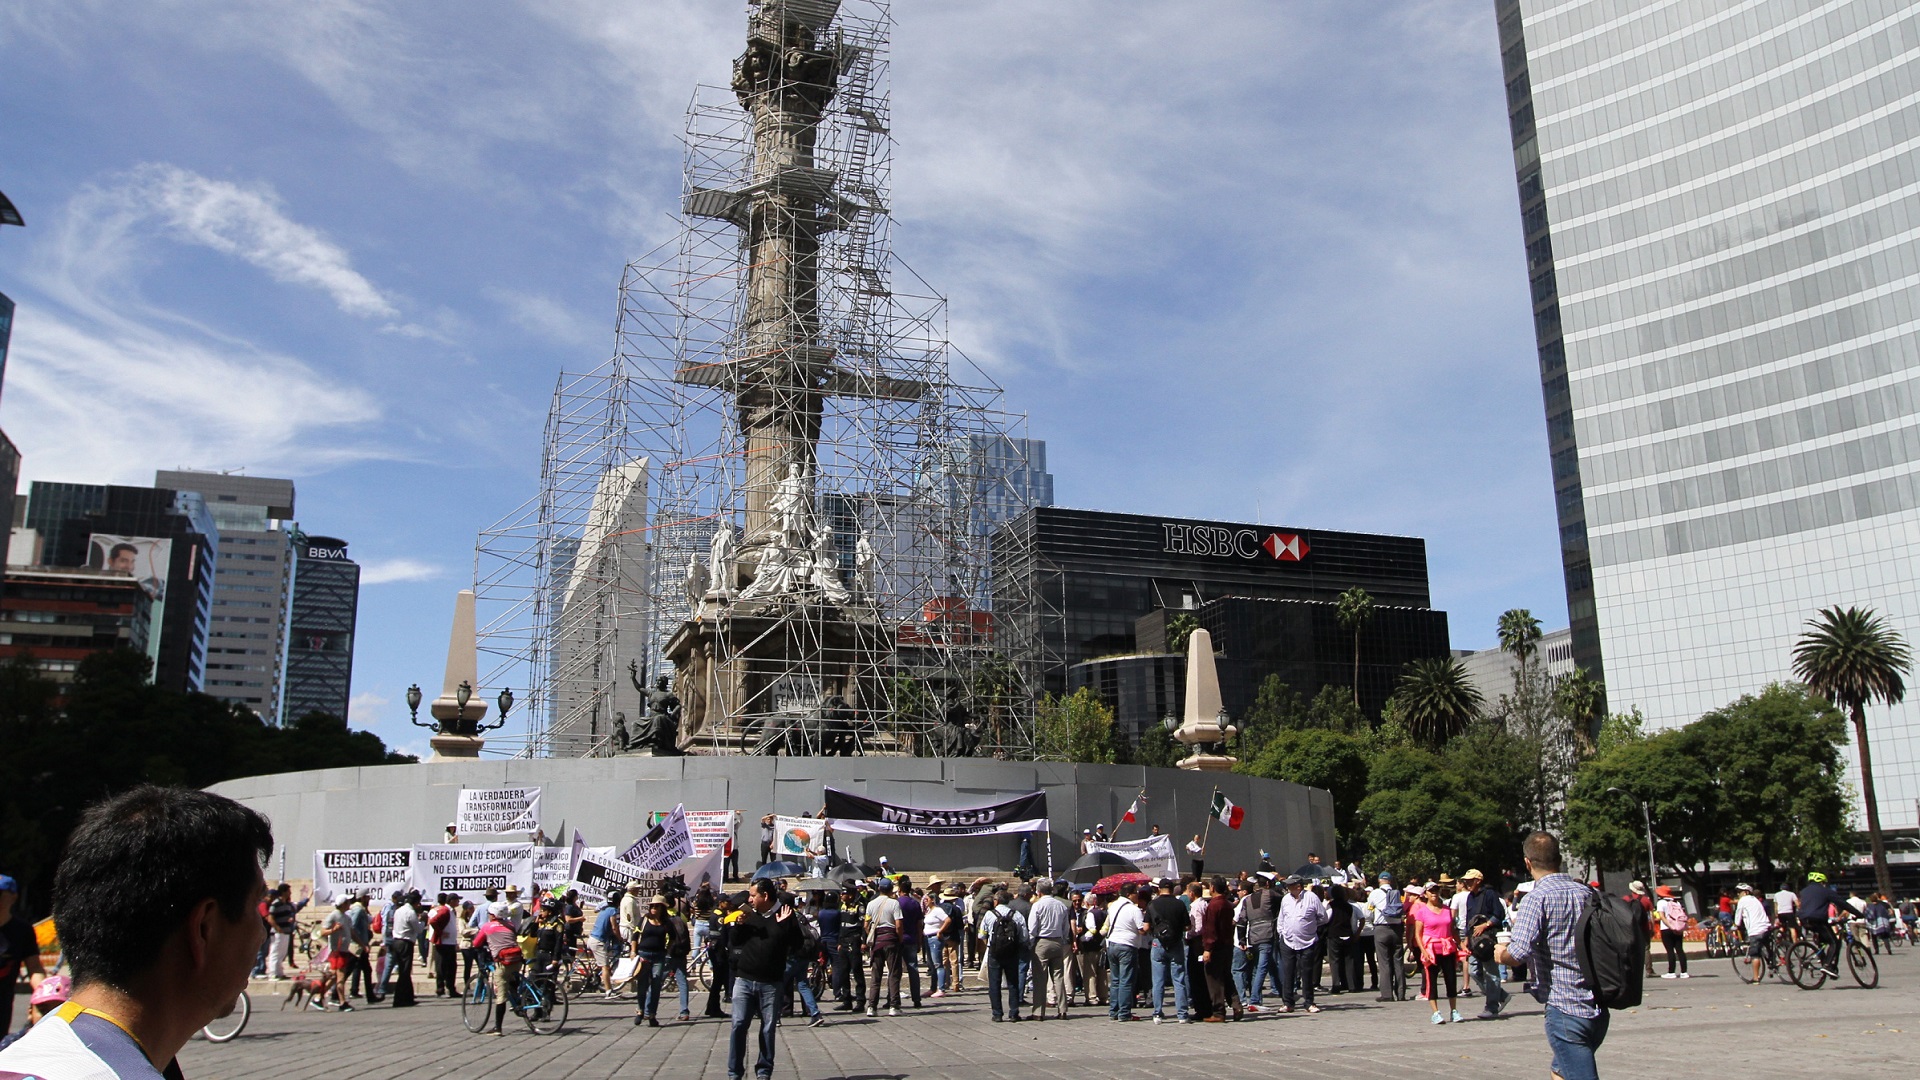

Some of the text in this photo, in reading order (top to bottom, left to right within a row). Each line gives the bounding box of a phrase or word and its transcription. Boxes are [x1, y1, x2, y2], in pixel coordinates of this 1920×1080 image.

[1162, 523, 1259, 559] HSBC
[309, 547, 345, 559] BBVA
[470, 789, 525, 801] LA VERDADERA
[466, 800, 530, 811] TRANSFORMACIÓN
[464, 813, 472, 822] DE
[460, 820, 537, 832] EL PODER CIUDADANO
[663, 830, 690, 852] CONTRA
[417, 848, 532, 860] EL CRECIMIENTO ECONÓMICO
[626, 836, 651, 861] TOTAL
[328, 852, 406, 867] LEGISLADORES:
[433, 863, 515, 874] NO ES UN CAPRICHO.
[586, 853, 595, 862] LA
[599, 856, 654, 880] CONVOCATORIA
[328, 870, 406, 883] TRABAJEN PARA
[442, 877, 505, 889] ES PROGRESO
